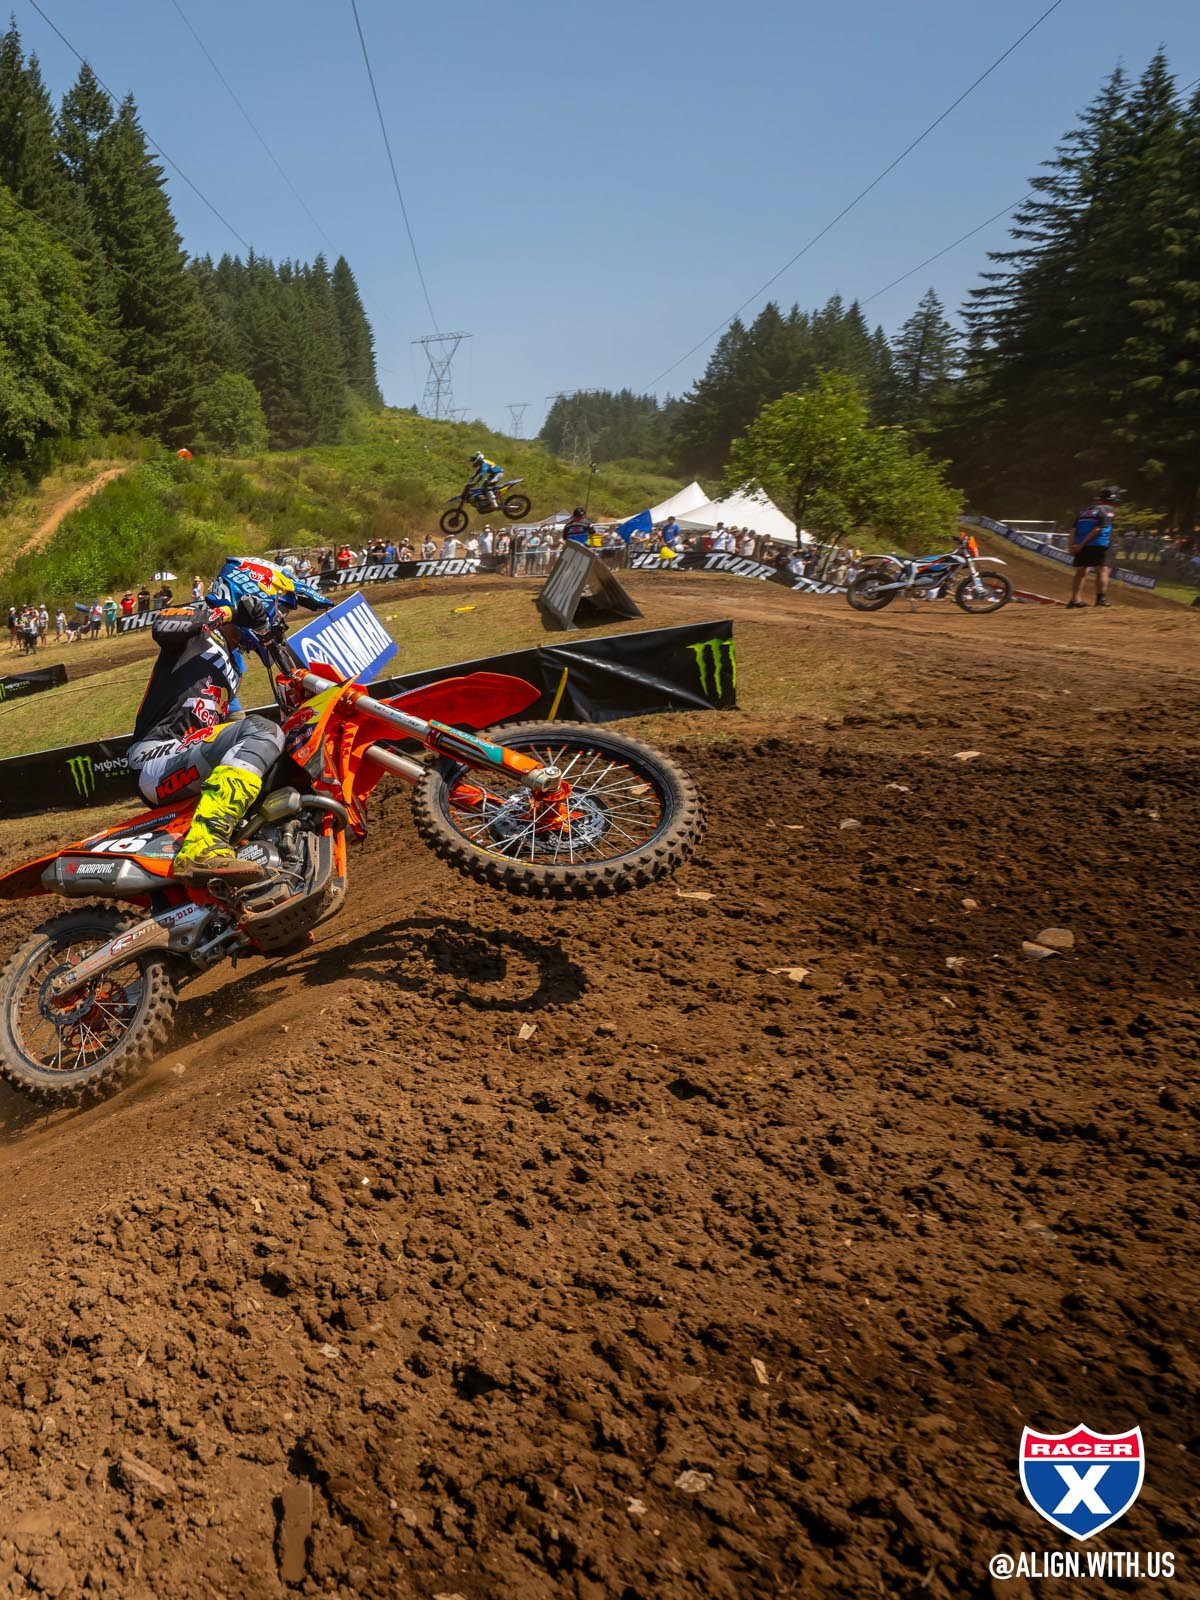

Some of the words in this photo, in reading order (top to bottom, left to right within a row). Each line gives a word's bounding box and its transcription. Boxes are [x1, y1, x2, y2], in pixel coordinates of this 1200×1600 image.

[336, 563, 399, 585] THOR
[416, 558, 481, 577] THOR
[704, 553, 777, 580] THOR
[316, 602, 393, 677] YAMAHA
[155, 765, 200, 800] KTM
